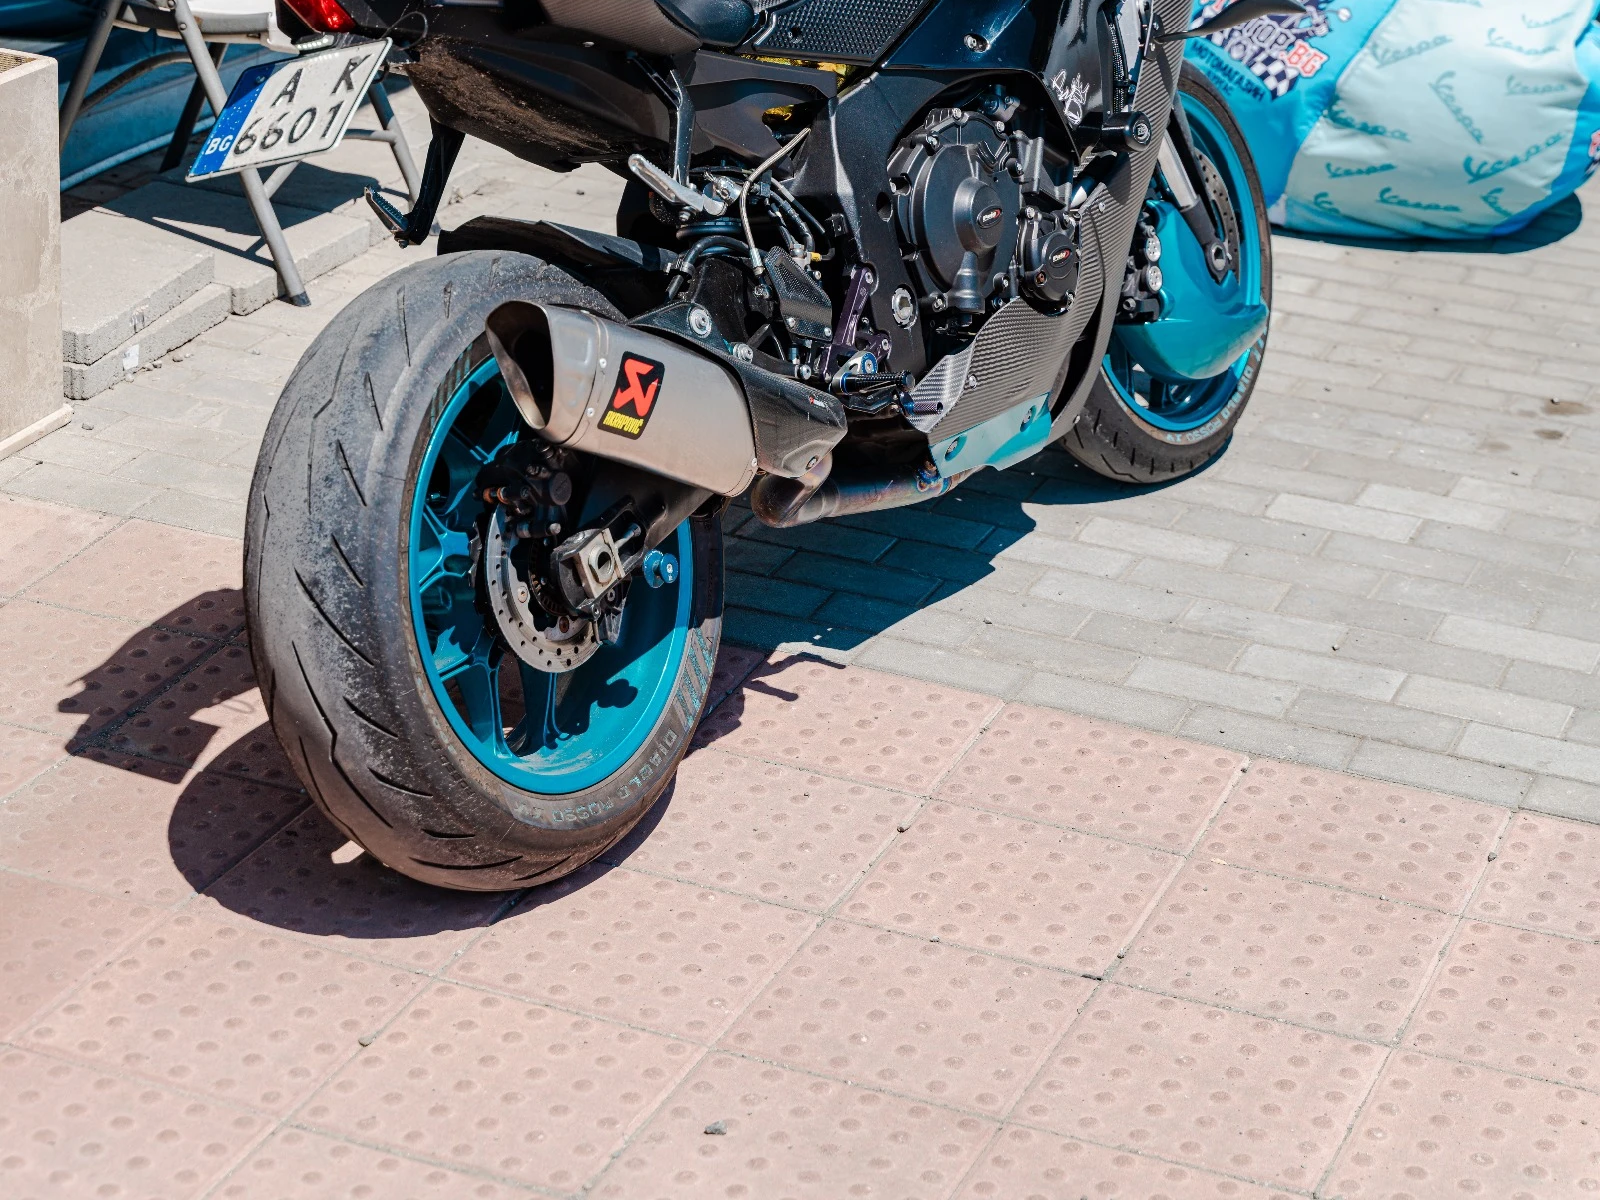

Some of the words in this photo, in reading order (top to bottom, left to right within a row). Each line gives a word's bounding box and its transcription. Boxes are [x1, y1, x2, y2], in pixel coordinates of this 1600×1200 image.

[270, 67, 304, 109] A
[331, 53, 375, 96] K
[233, 100, 346, 156] 6601
[204, 135, 234, 156] BG
[1324, 162, 1397, 179] Vespa
[1376, 187, 1462, 212] Vespa
